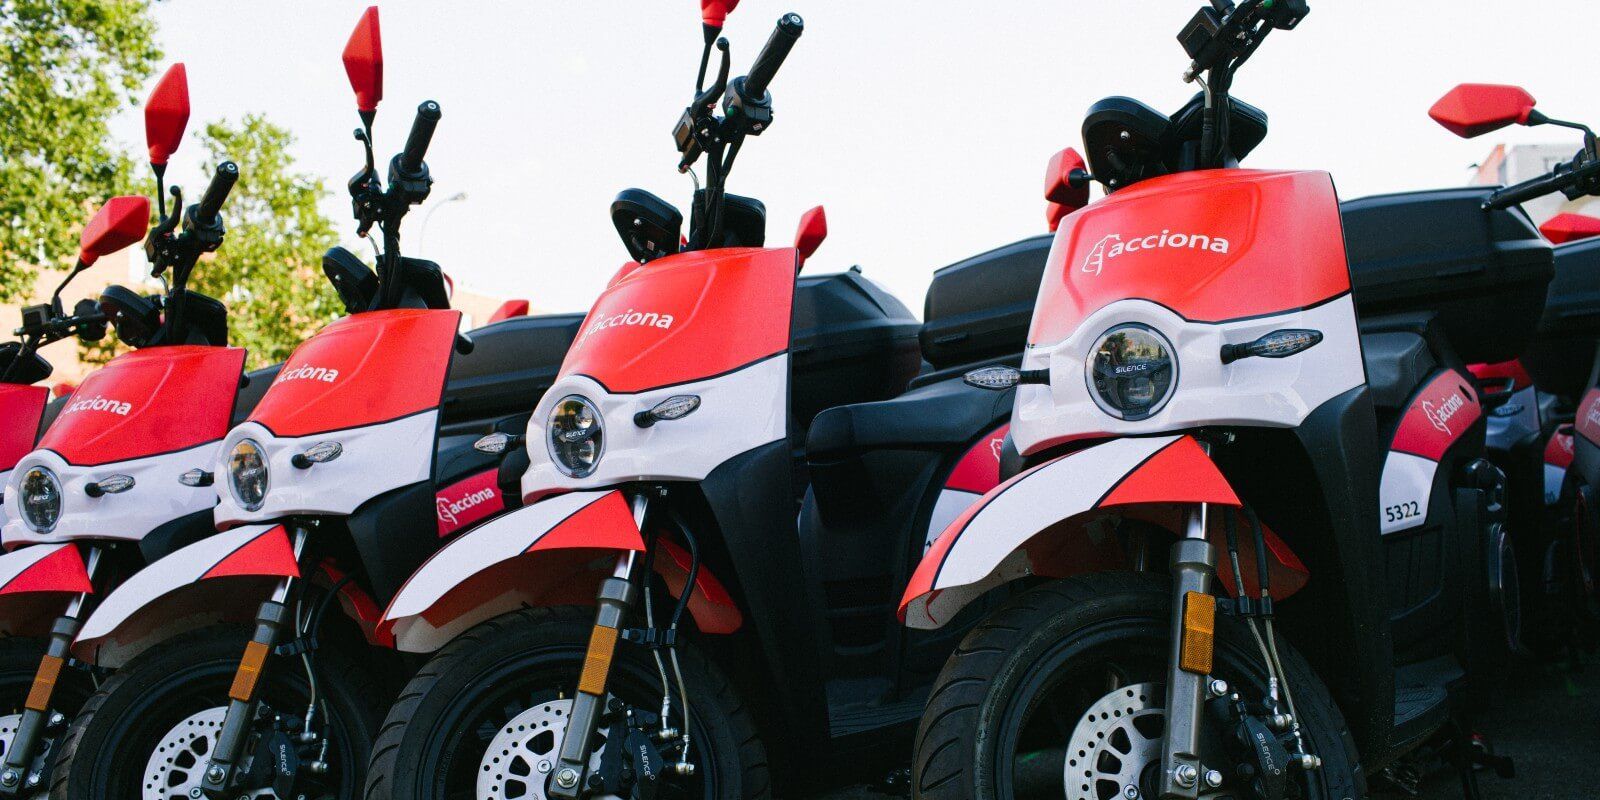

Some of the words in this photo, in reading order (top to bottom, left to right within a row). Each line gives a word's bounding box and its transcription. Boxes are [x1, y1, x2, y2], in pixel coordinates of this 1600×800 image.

[1107, 229, 1230, 257] acciona
[1115, 363, 1147, 374] SILENCE
[1436, 393, 1463, 422] acciona
[449, 487, 495, 515] acciona
[1385, 500, 1421, 522] 5322
[640, 744, 651, 776] SILENCE
[1256, 732, 1275, 771] SILENCE
